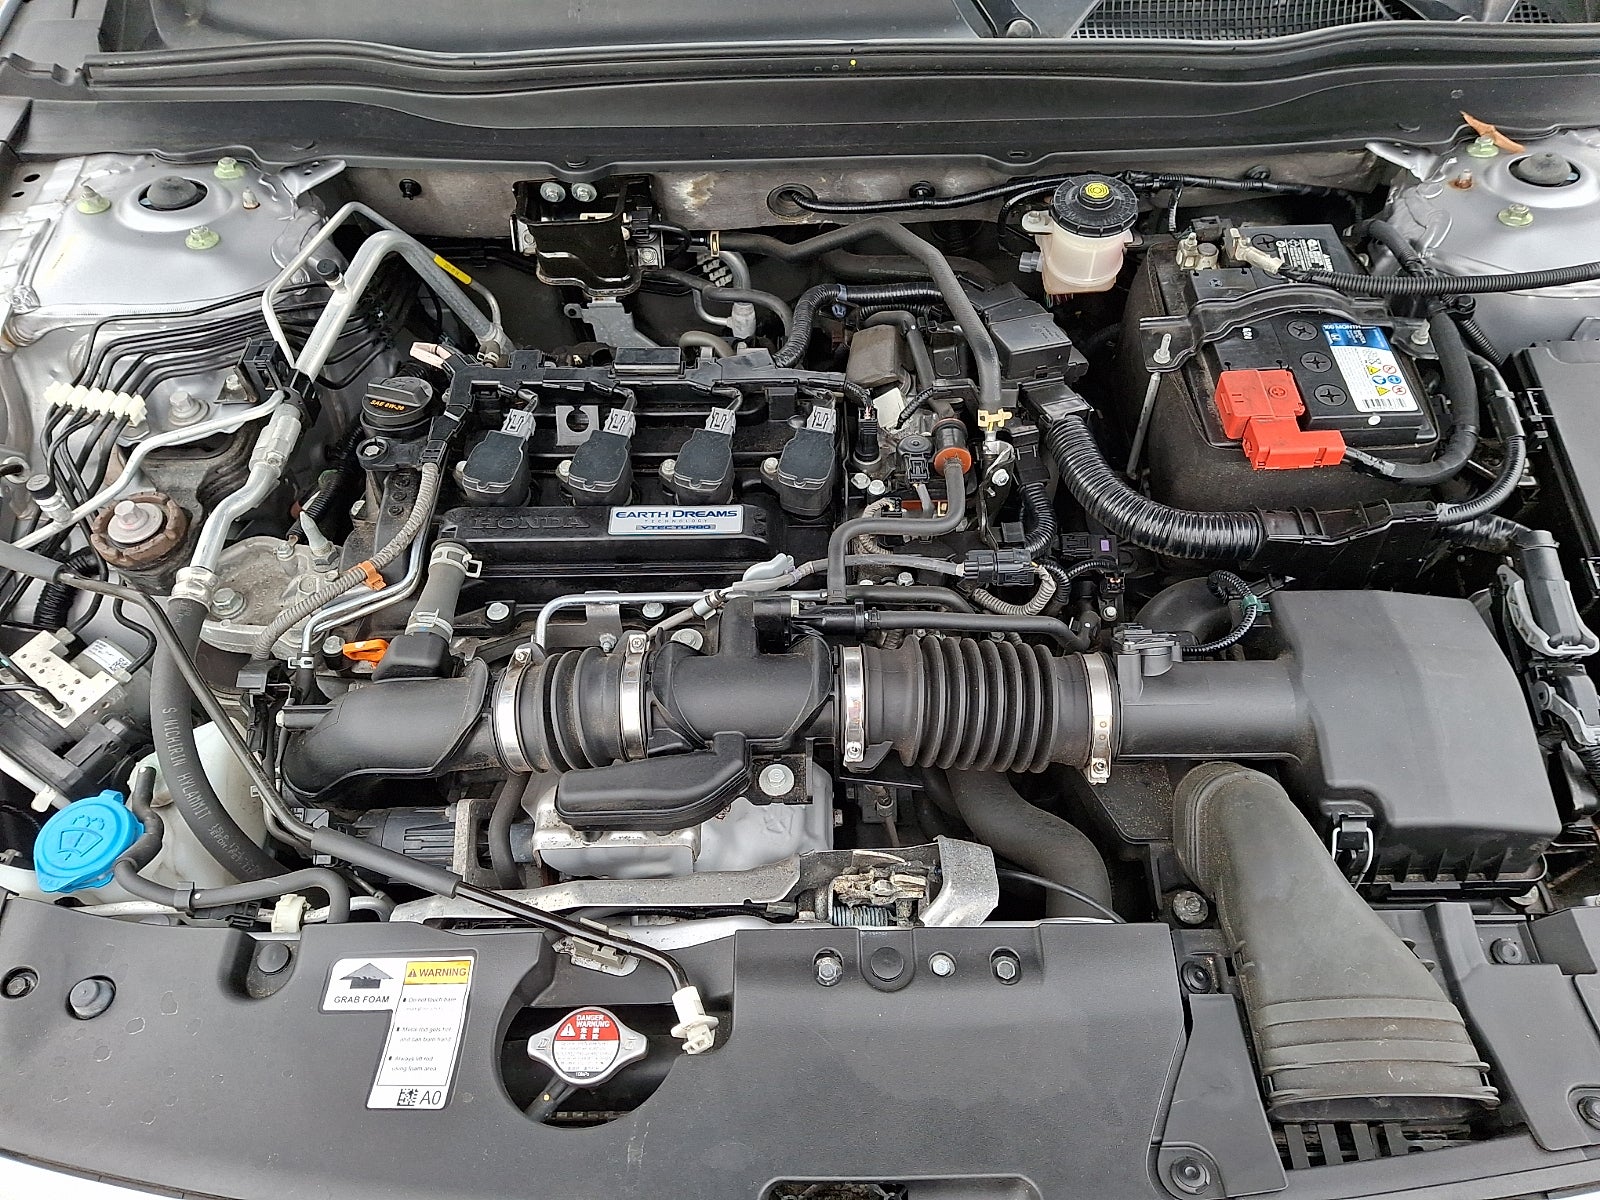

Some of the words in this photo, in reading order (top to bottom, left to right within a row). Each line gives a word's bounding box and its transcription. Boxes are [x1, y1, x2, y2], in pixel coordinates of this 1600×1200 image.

[384, 402, 405, 411] 0W-20
[616, 510, 668, 518] EARTH
[673, 510, 738, 518] DREAMS
[473, 517, 590, 529] HONDA
[420, 967, 467, 977] WARNING
[334, 995, 360, 1003] GRAB
[363, 995, 389, 1003] FOAM
[420, 1090, 442, 1105] A0
